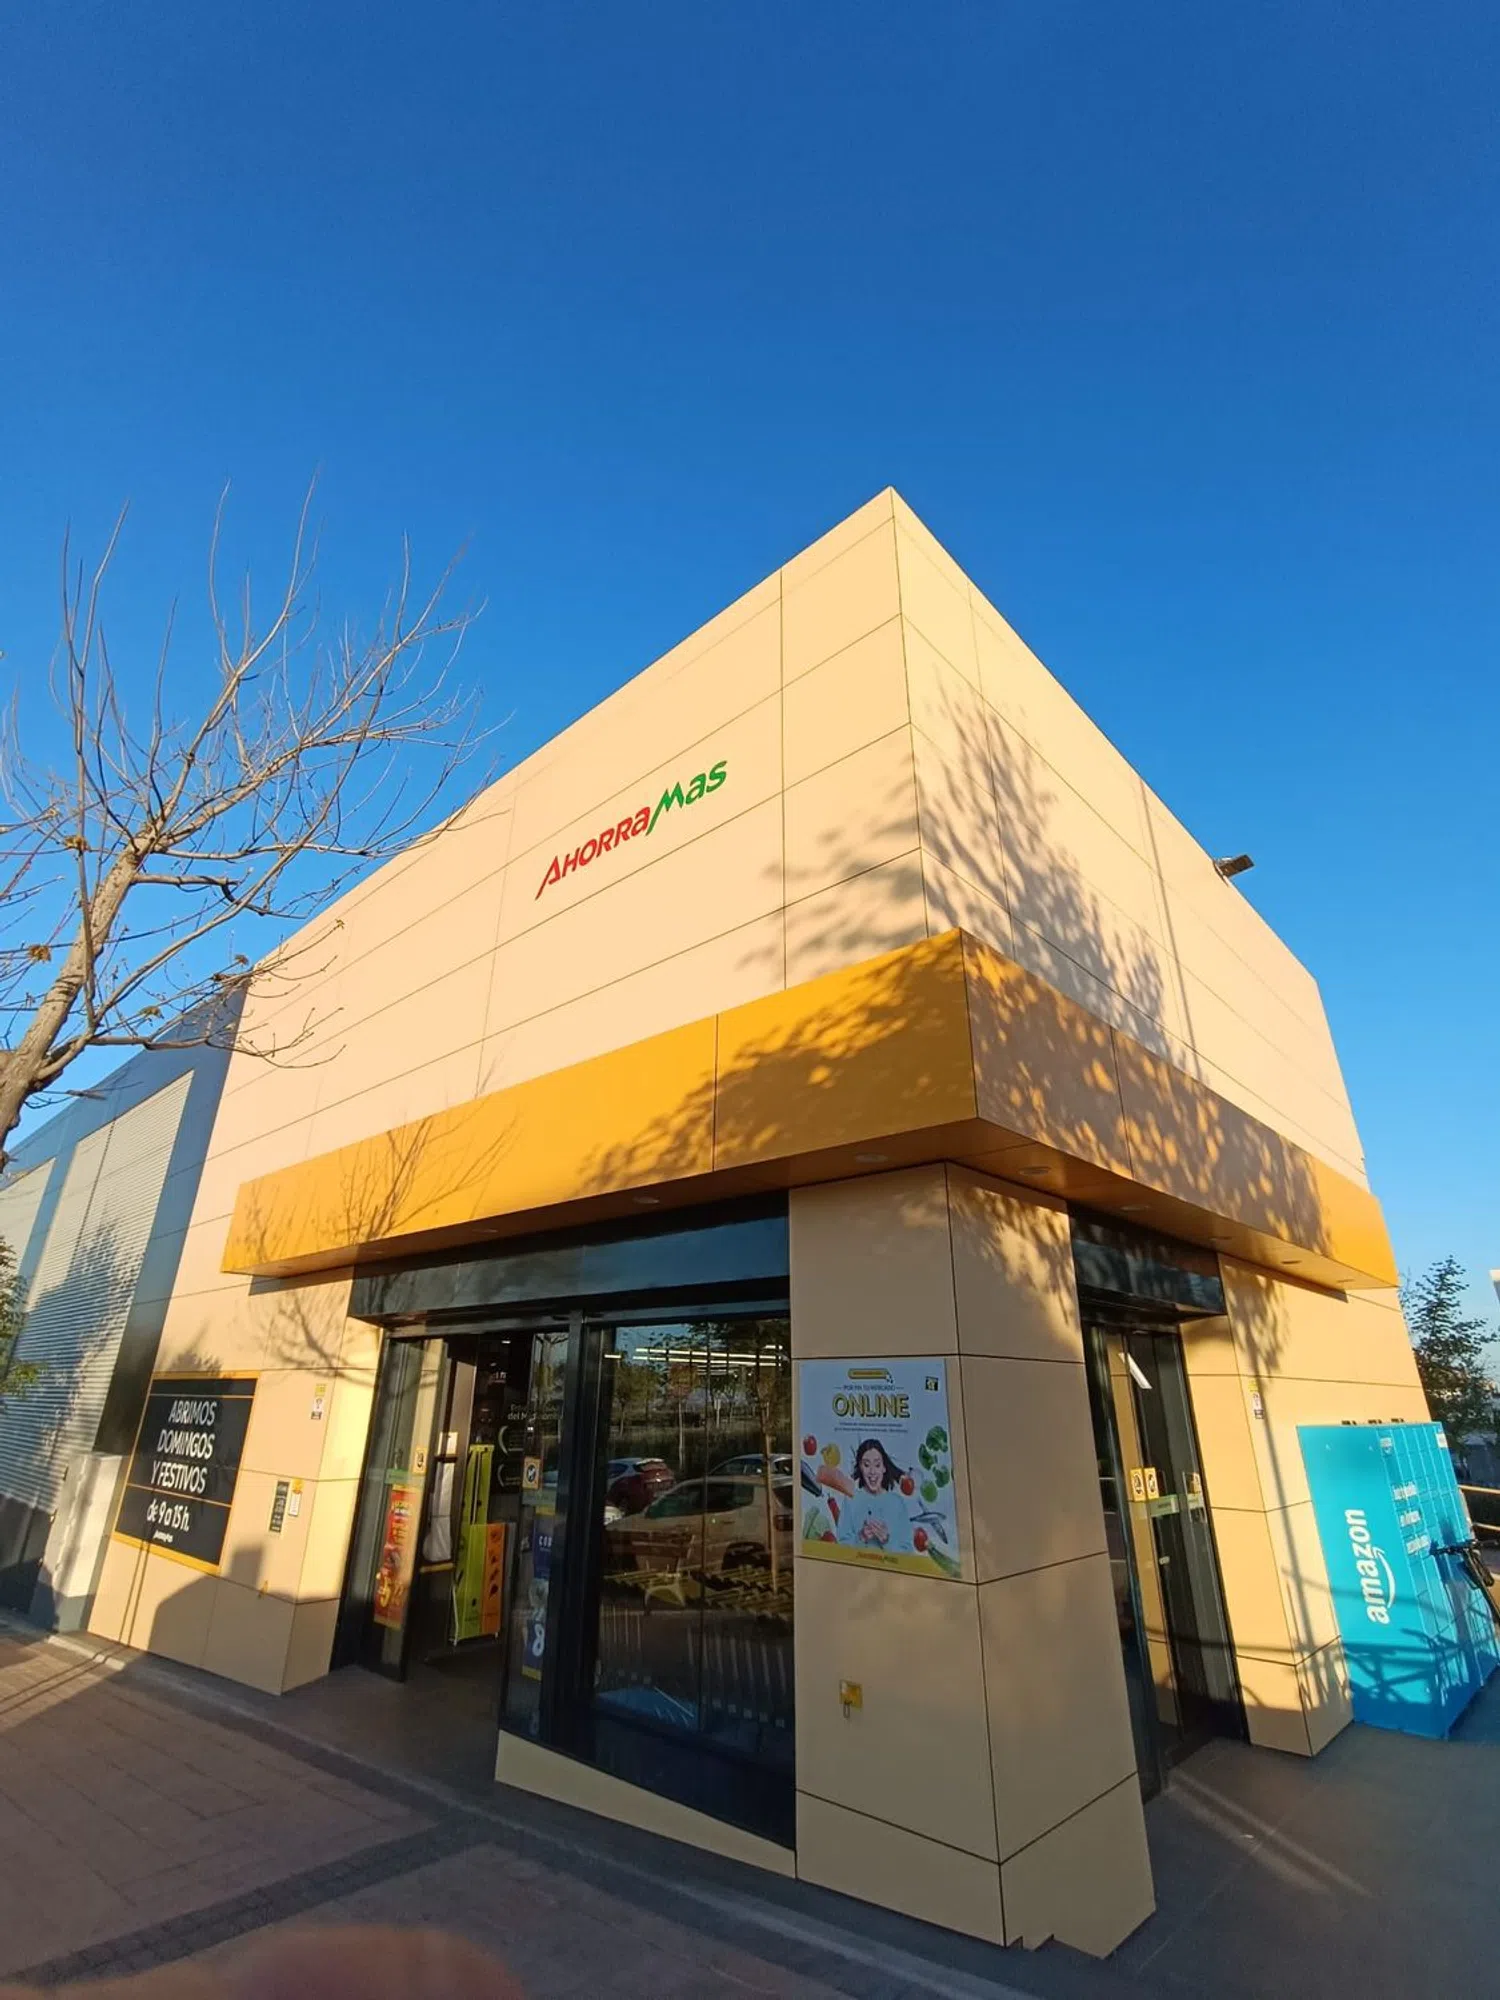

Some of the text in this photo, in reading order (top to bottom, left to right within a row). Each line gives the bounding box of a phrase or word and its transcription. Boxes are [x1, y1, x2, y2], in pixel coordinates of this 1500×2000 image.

[168, 1400, 217, 1426] ABRIMOS
[832, 1393, 910, 1419] ONLINE
[157, 1429, 215, 1460] DOMINGOS
[151, 1460, 208, 1494] Y FESTIVOS
[146, 1498, 159, 1522] de
[158, 1501, 167, 1524] 9
[171, 1504, 184, 1529] 15
[1344, 1508, 1390, 1625] amazon
